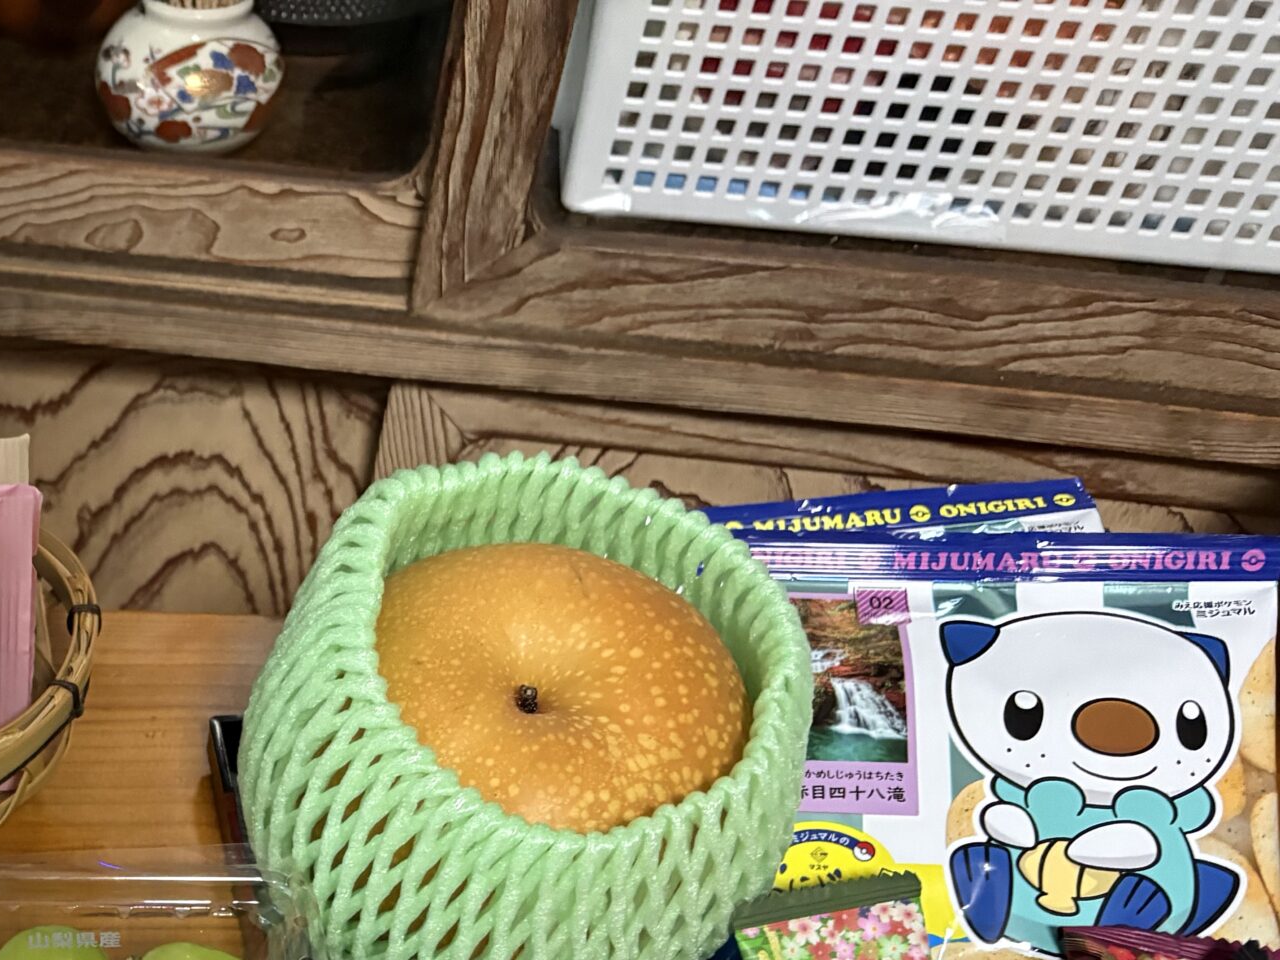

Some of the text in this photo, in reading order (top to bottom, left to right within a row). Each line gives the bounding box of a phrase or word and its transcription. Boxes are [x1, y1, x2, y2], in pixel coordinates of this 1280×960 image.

[753, 496, 1047, 533] MIJUMARU ONIGIRI
[892, 551, 1060, 573] MIJUMARU
[1110, 549, 1230, 571] ONIGIRI
[869, 595, 894, 610] 02
[1196, 607, 1256, 618] ミジュマル
[804, 769, 904, 781] かめしじゅうはちたき
[28, 931, 122, 950] 山梨県産
